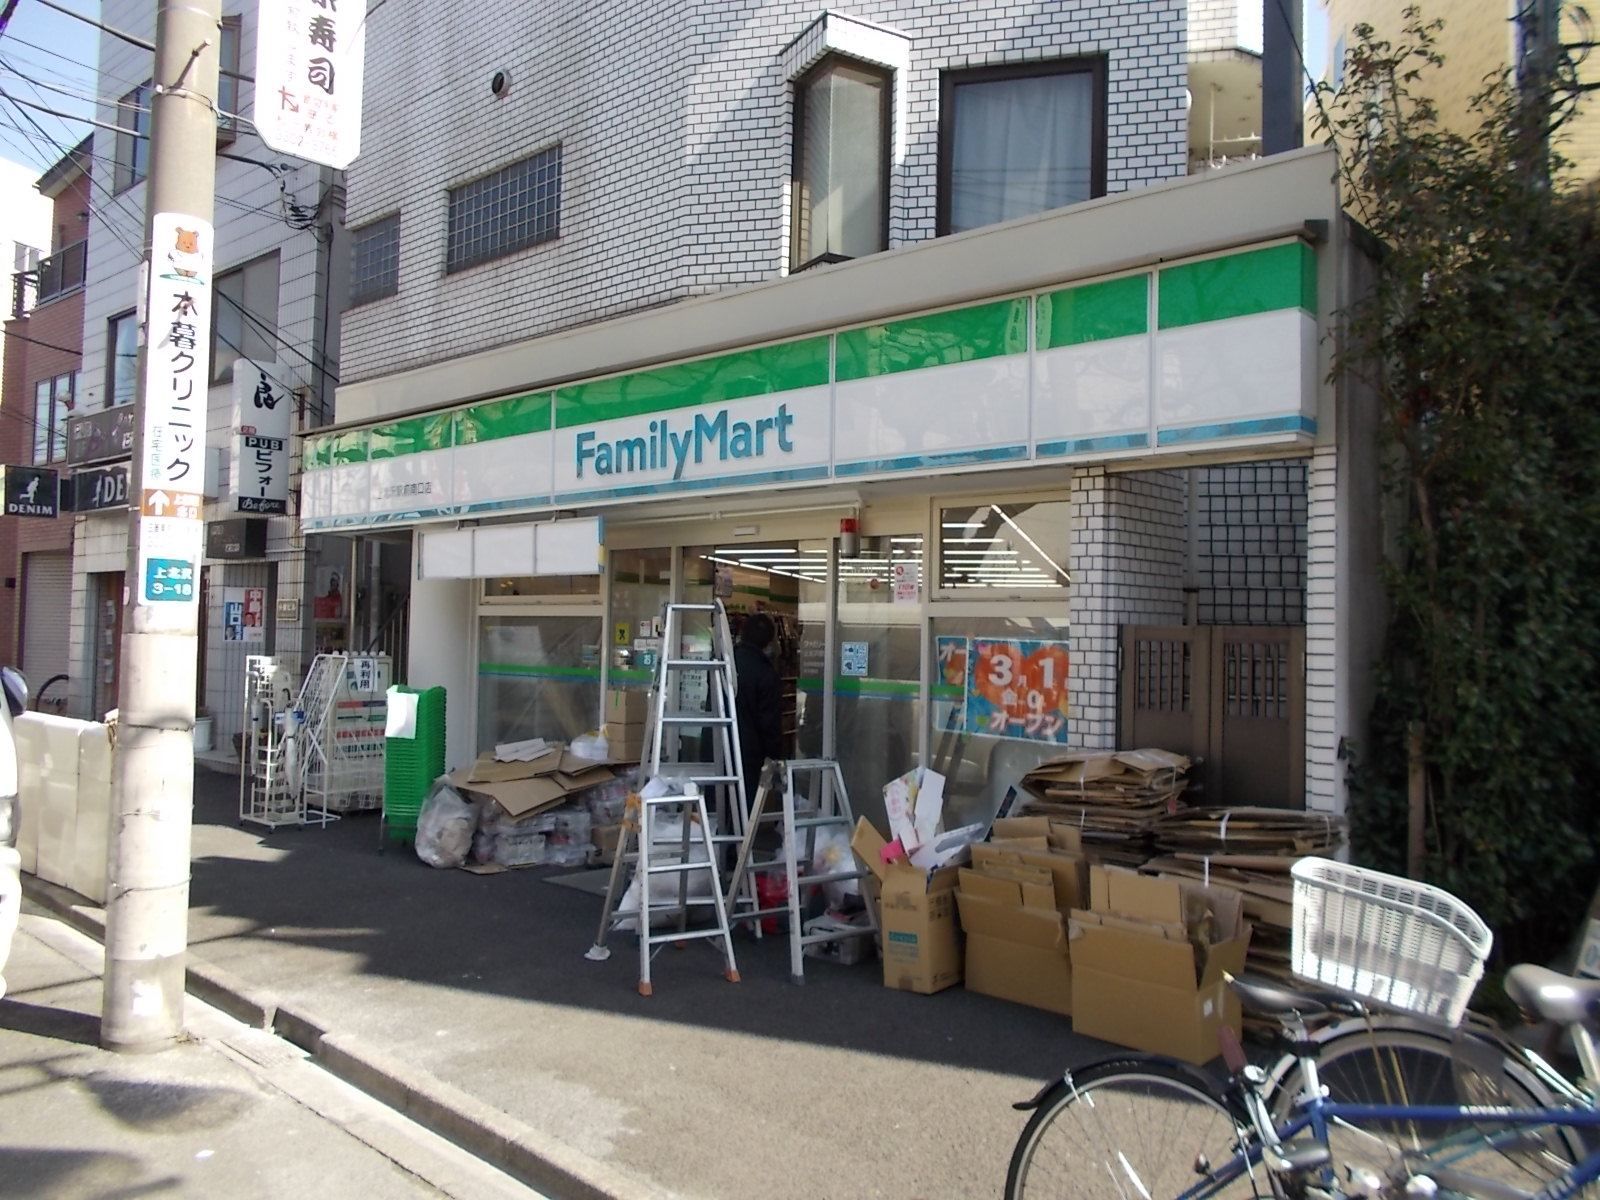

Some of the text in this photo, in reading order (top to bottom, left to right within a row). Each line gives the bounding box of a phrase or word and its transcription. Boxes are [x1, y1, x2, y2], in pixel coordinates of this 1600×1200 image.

[166, 290, 198, 482] 木暮クリニック
[248, 438, 280, 450] PUB
[576, 402, 794, 481] FamilyMart
[255, 450, 273, 497] ビフォー
[104, 473, 130, 503] DE
[8, 503, 53, 515] DENIM
[241, 498, 281, 512] Before
[229, 603, 242, 626] 山口
[360, 660, 371, 690] 再利用
[990, 711, 1063, 736] オープン
